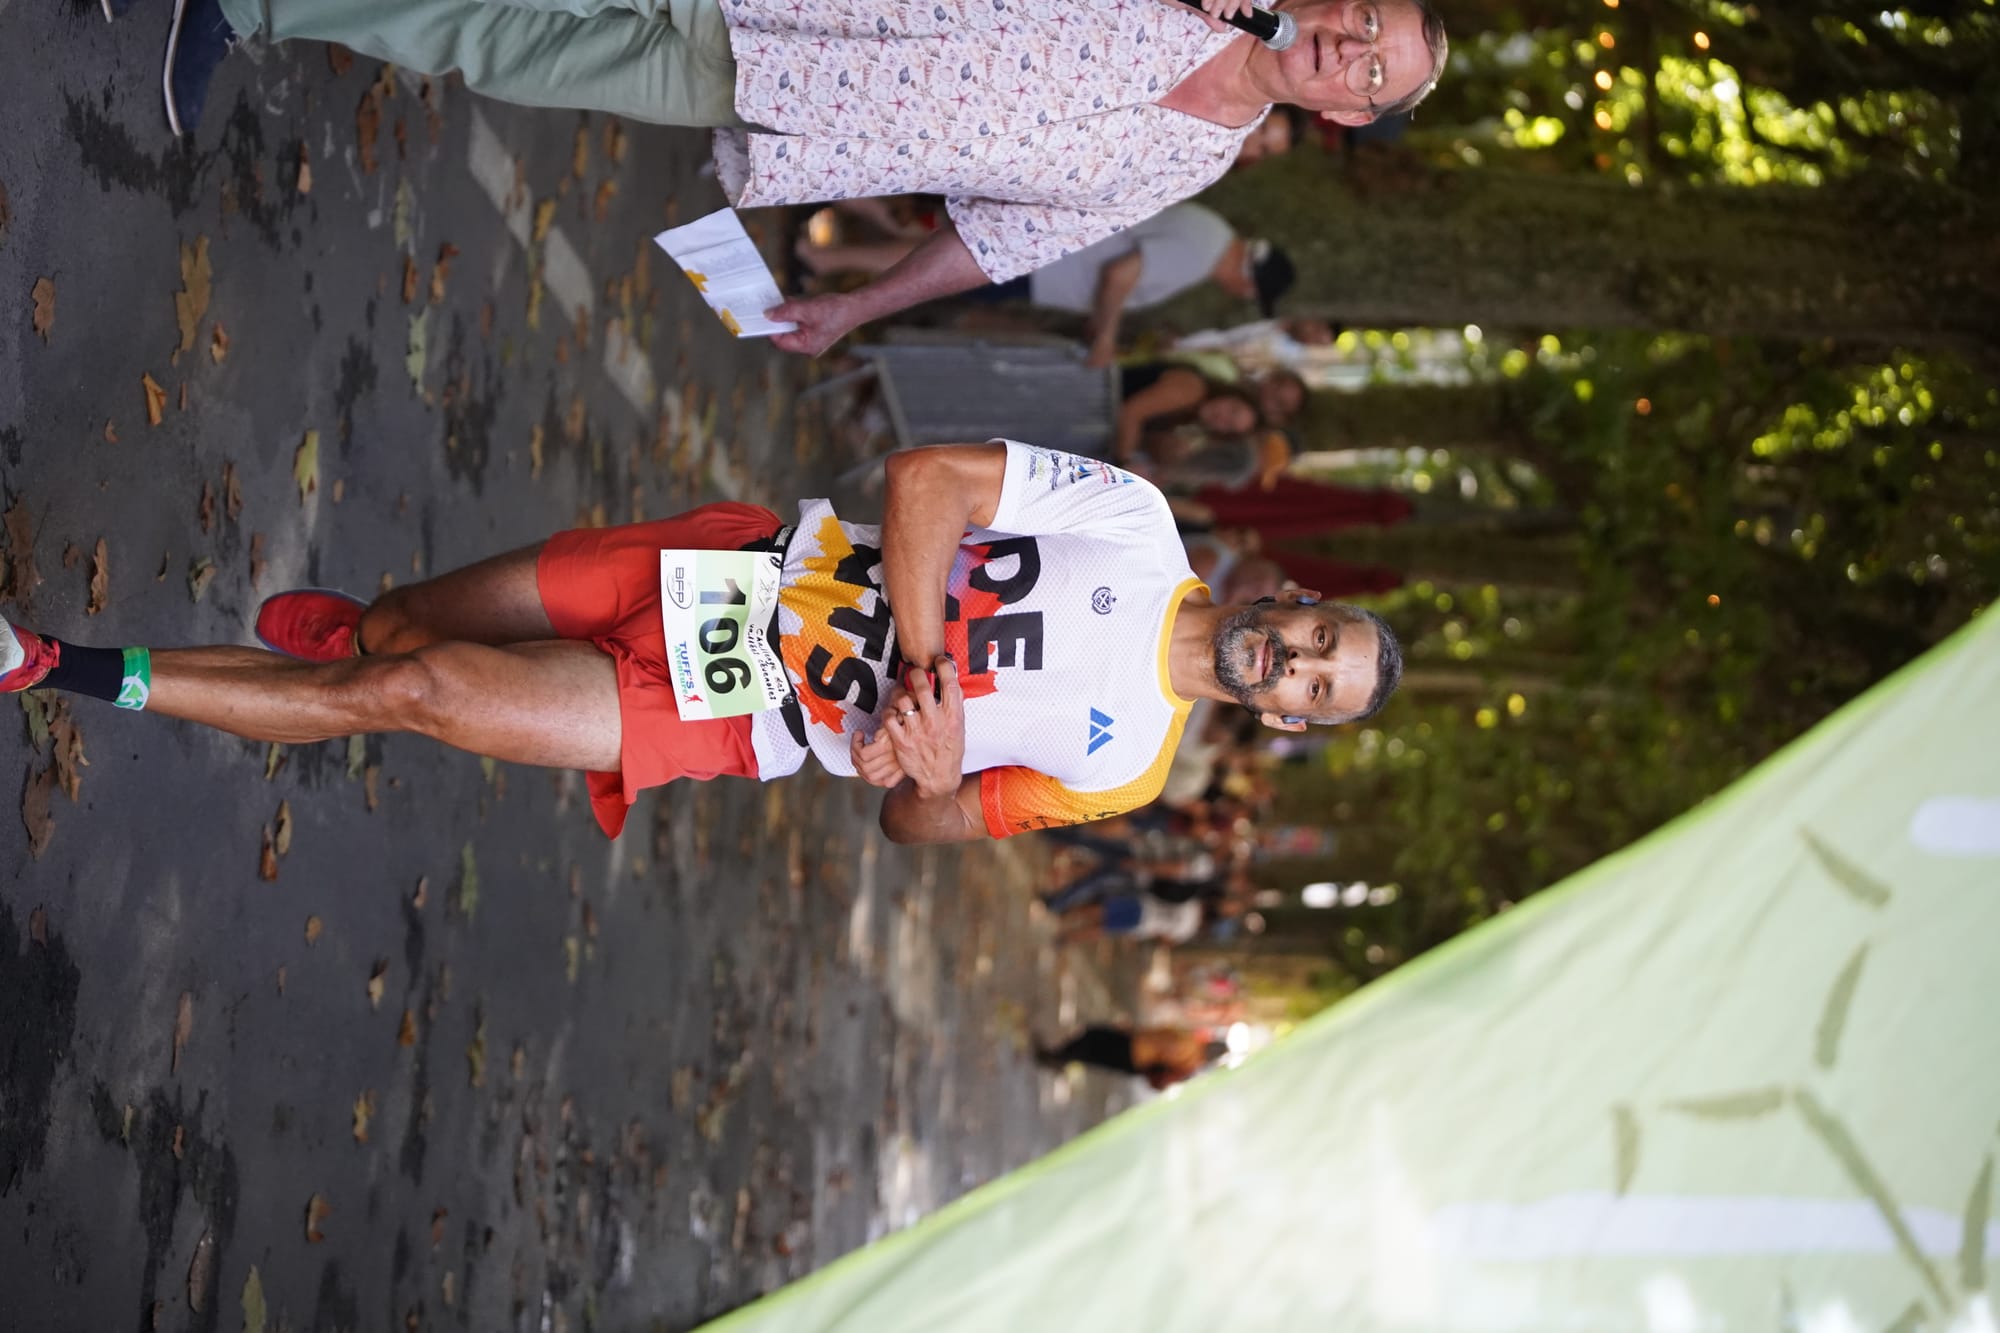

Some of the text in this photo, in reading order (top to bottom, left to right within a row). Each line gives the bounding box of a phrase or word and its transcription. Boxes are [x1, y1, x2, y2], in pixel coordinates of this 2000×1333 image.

[675, 567, 685, 603] BFP
[699, 578, 751, 694] 106
[756, 628, 777, 671] Challenge
[674, 646, 688, 695] Aventure
[679, 641, 695, 690] TUFF'S
